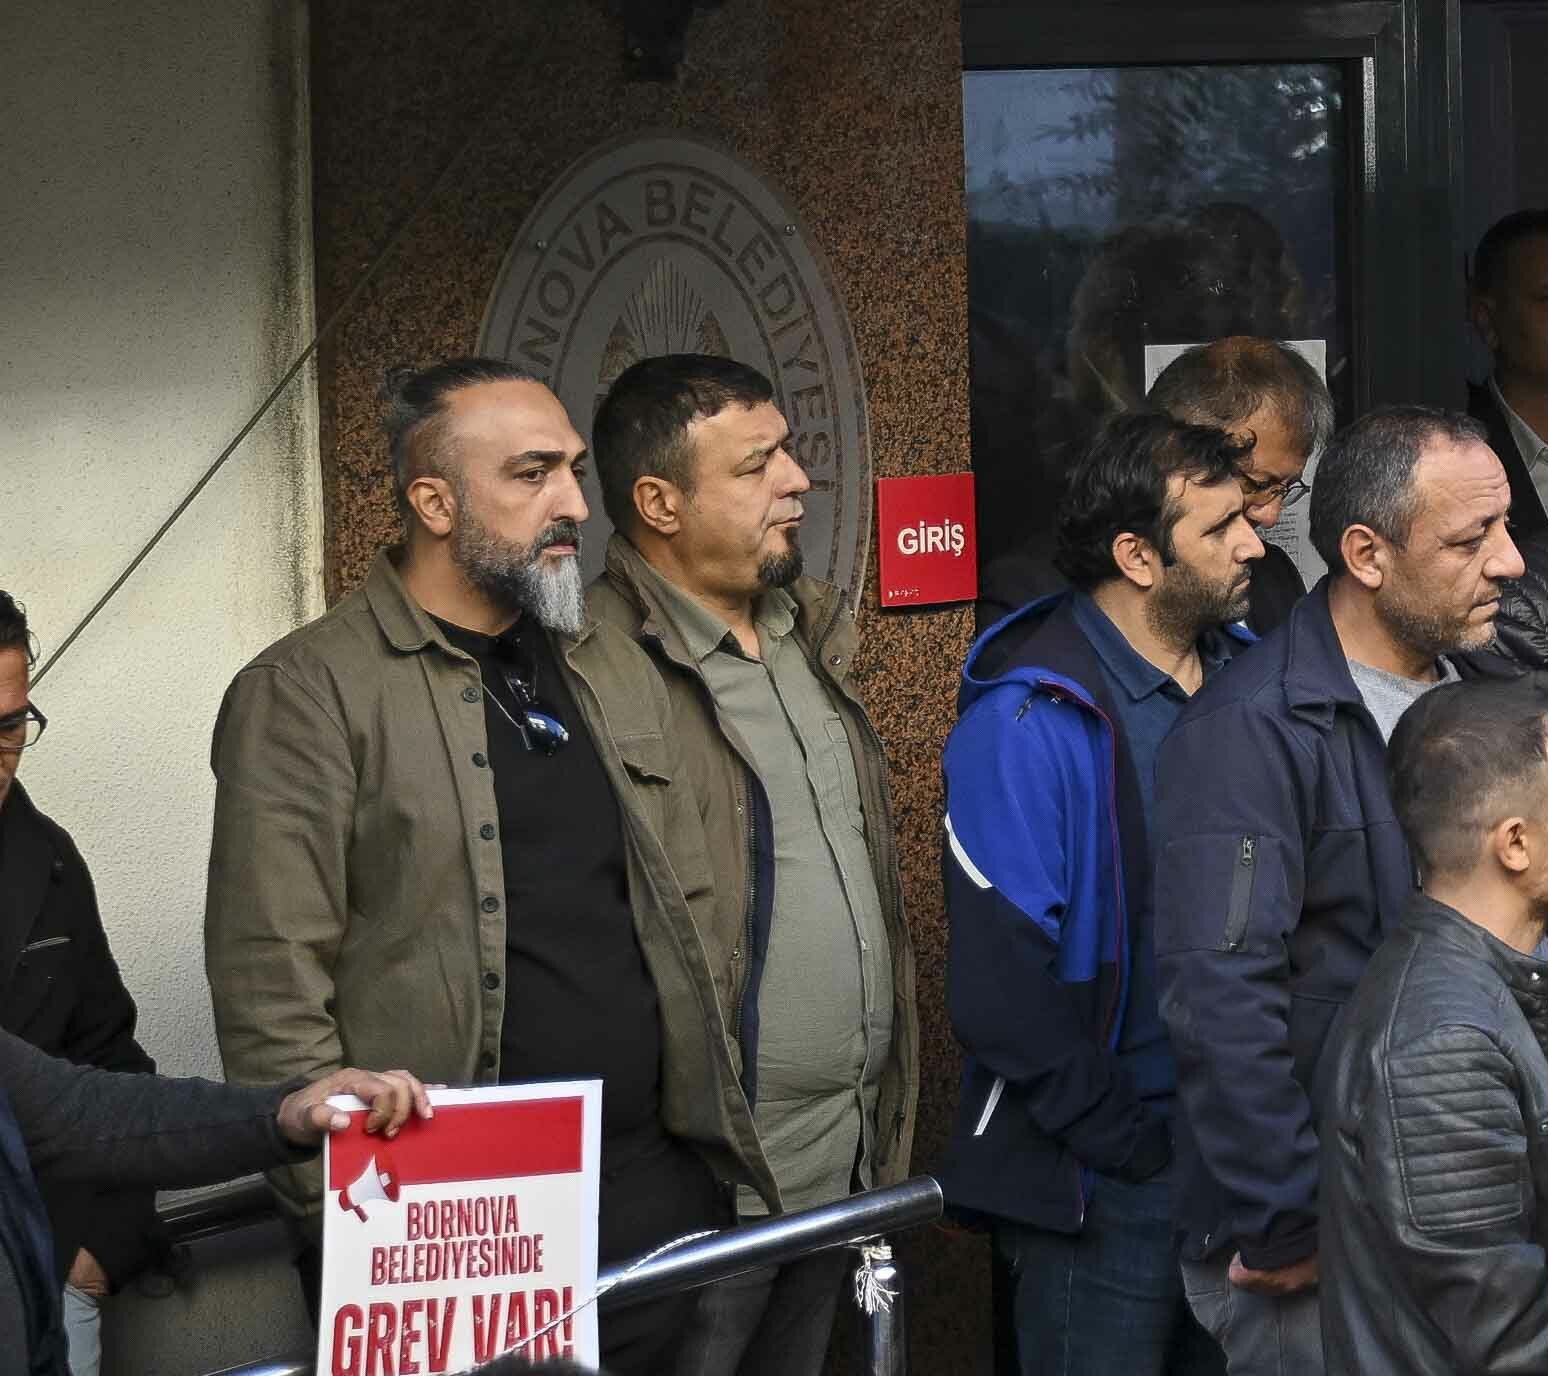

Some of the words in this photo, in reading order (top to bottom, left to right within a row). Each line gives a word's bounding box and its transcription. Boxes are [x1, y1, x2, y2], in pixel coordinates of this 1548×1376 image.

[897, 518, 965, 557] GİRİŞ
[407, 1195, 520, 1241] BORNOVA
[472, 1286, 575, 1366] VAR!
